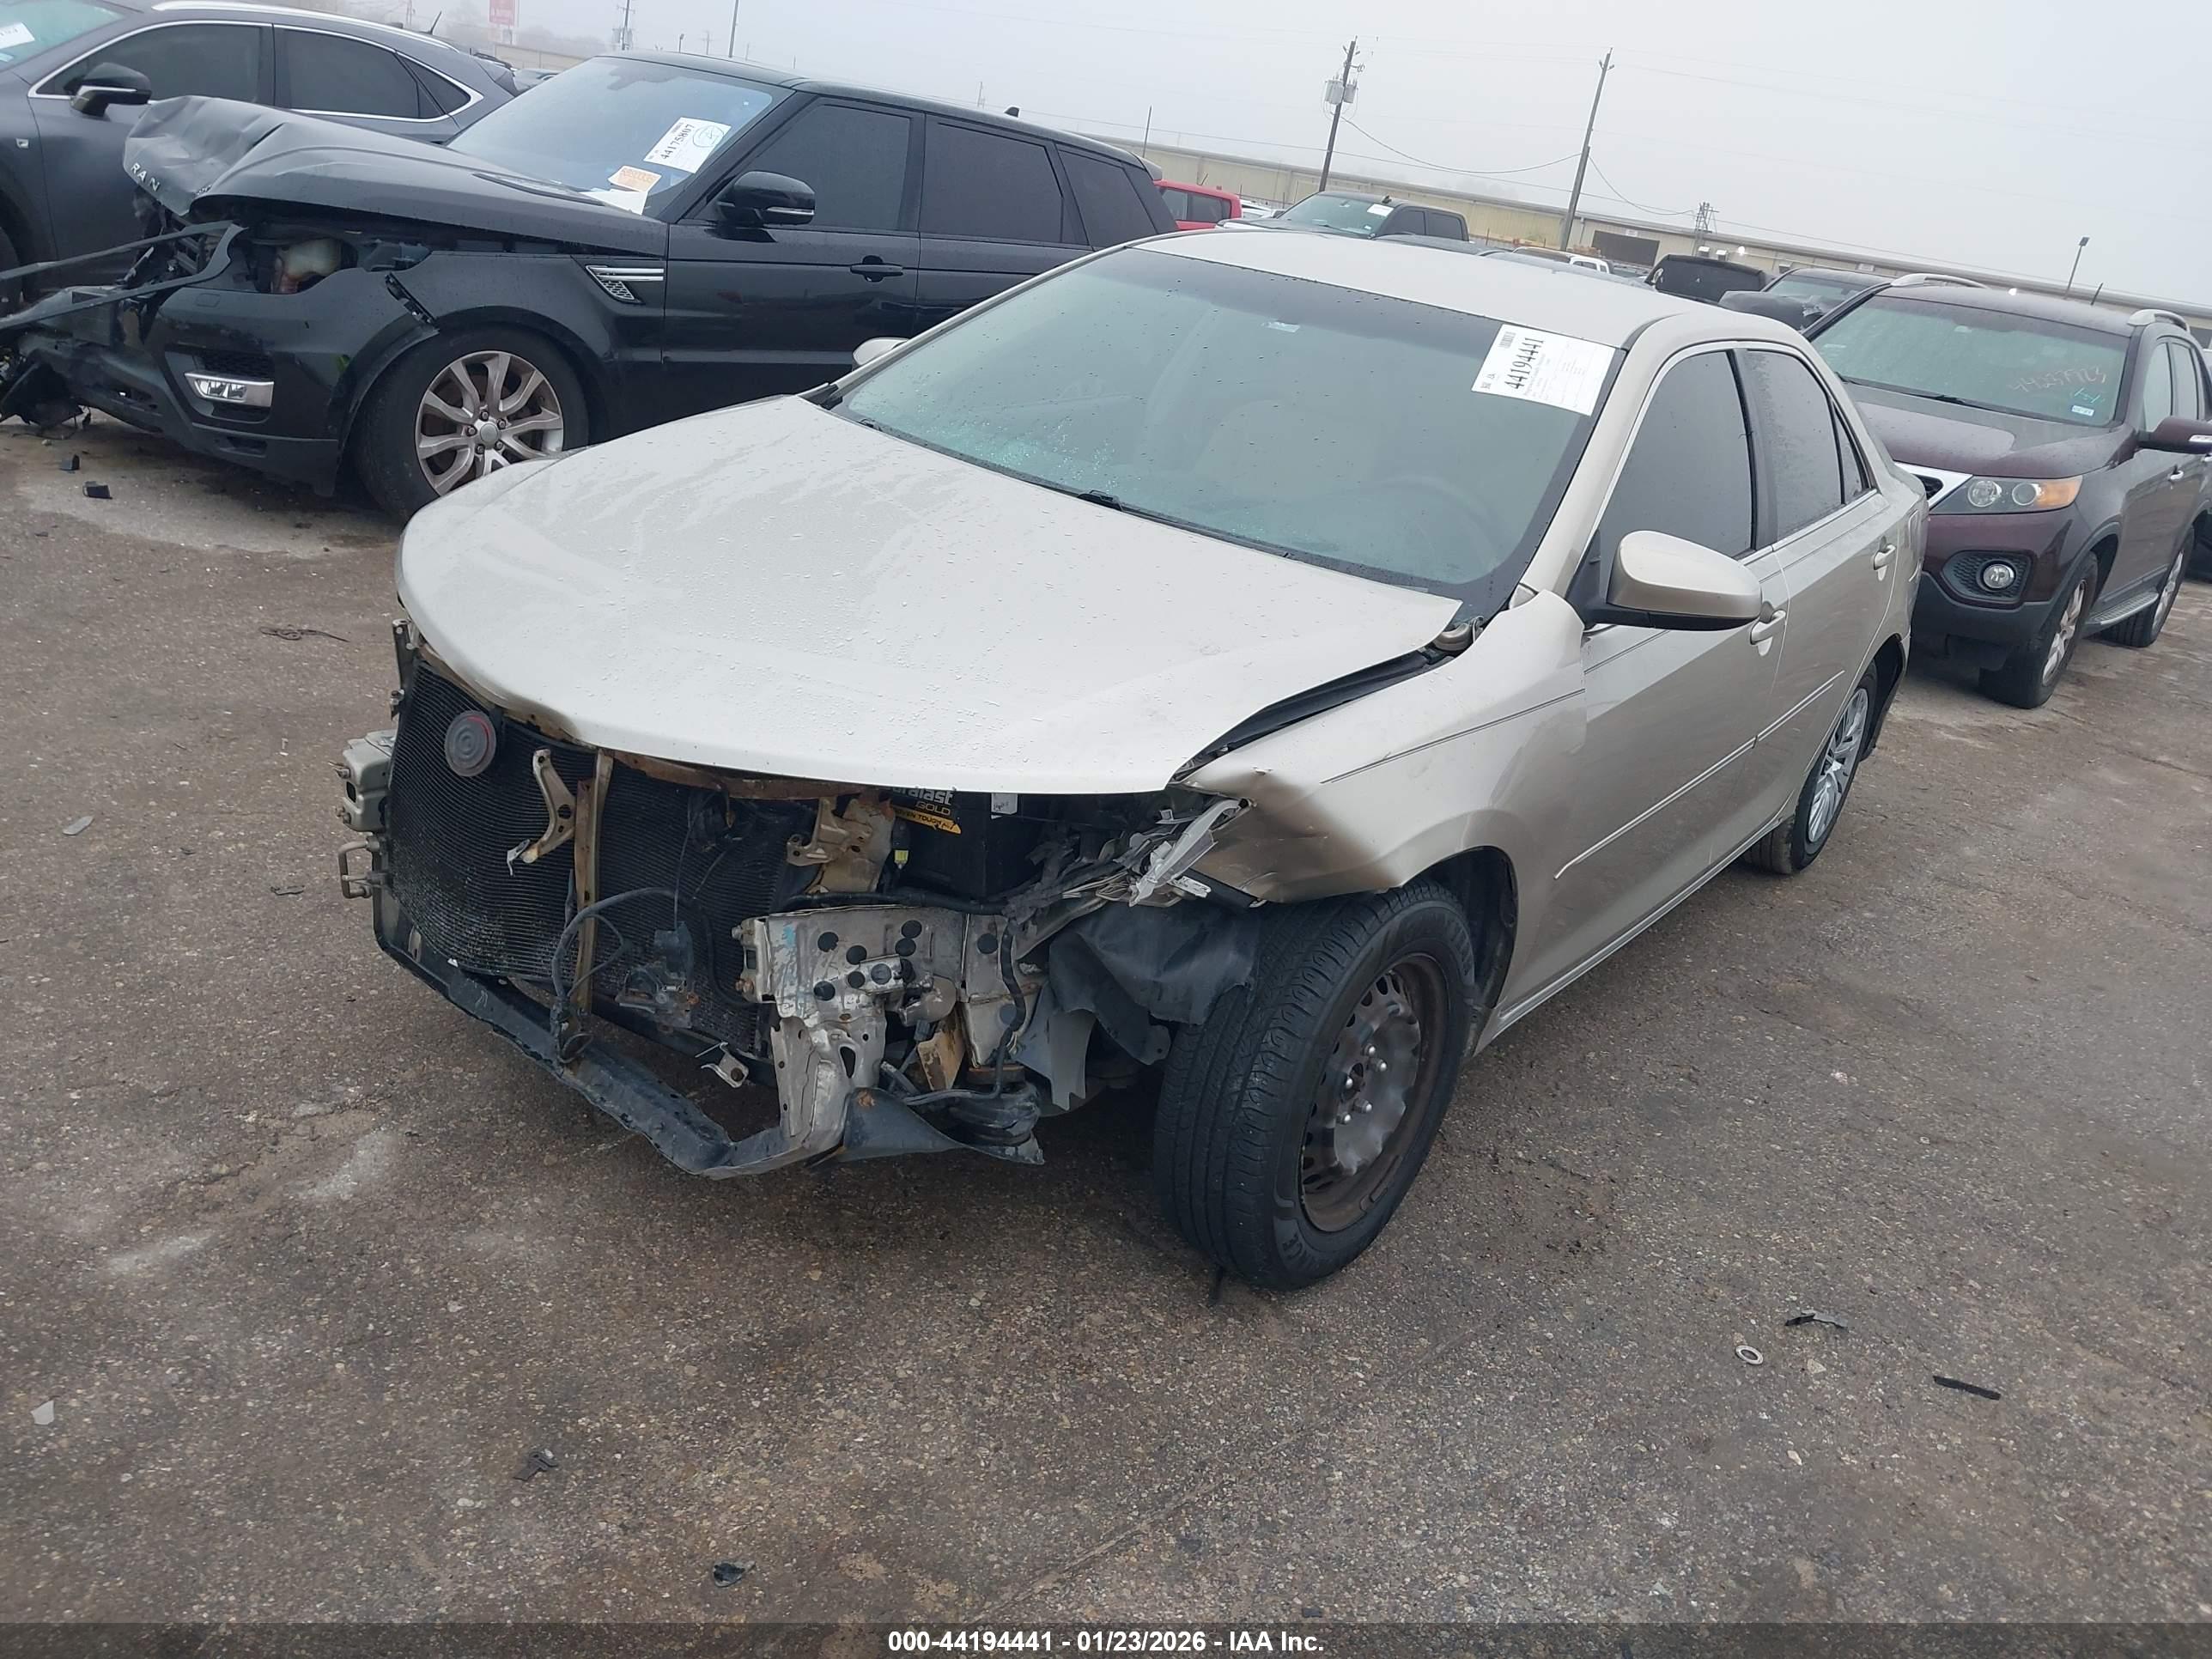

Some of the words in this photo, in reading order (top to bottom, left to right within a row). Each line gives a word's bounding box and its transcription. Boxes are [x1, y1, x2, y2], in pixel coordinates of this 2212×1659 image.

[660, 124, 695, 160] 44175807
[1504, 337, 1544, 390] 44194441
[915, 800, 951, 816] GOLD
